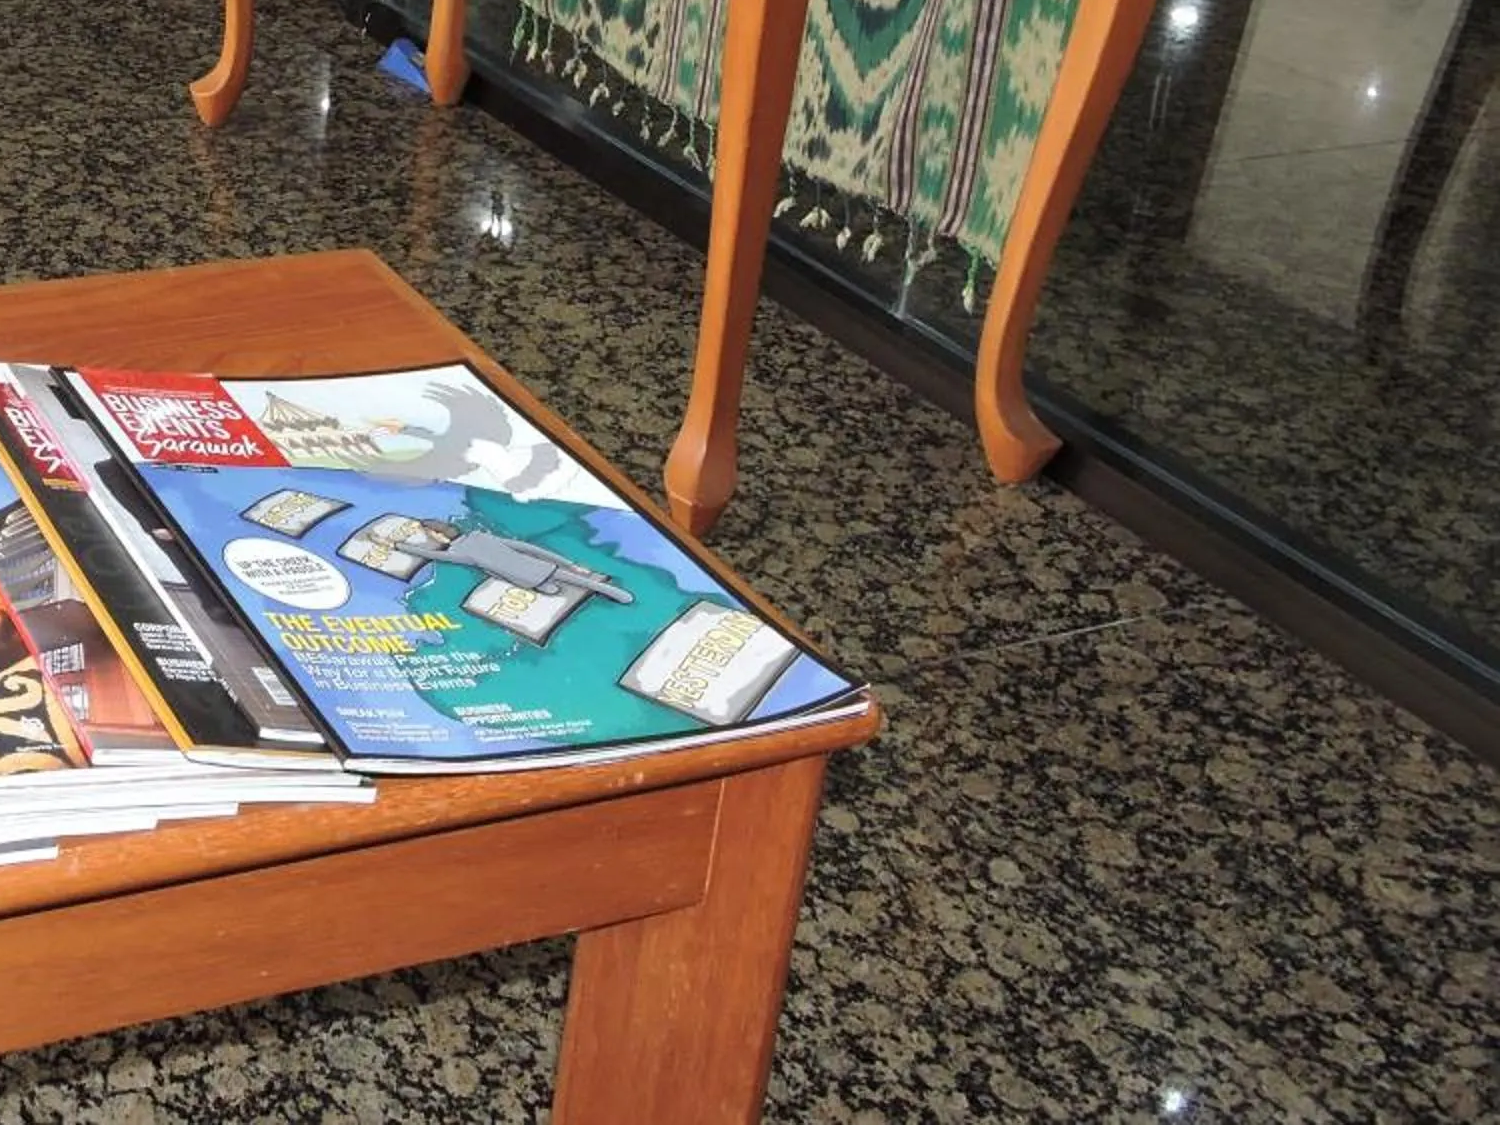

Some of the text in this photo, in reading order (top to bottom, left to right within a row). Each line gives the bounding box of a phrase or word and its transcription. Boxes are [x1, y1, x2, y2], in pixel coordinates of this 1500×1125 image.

[102, 393, 243, 420] BUSINESS
[115, 412, 231, 440] EVENTS
[135, 429, 264, 459] Sarawak
[263, 612, 463, 634] THE EVENTUAL
[280, 632, 417, 654] OUTCOME
